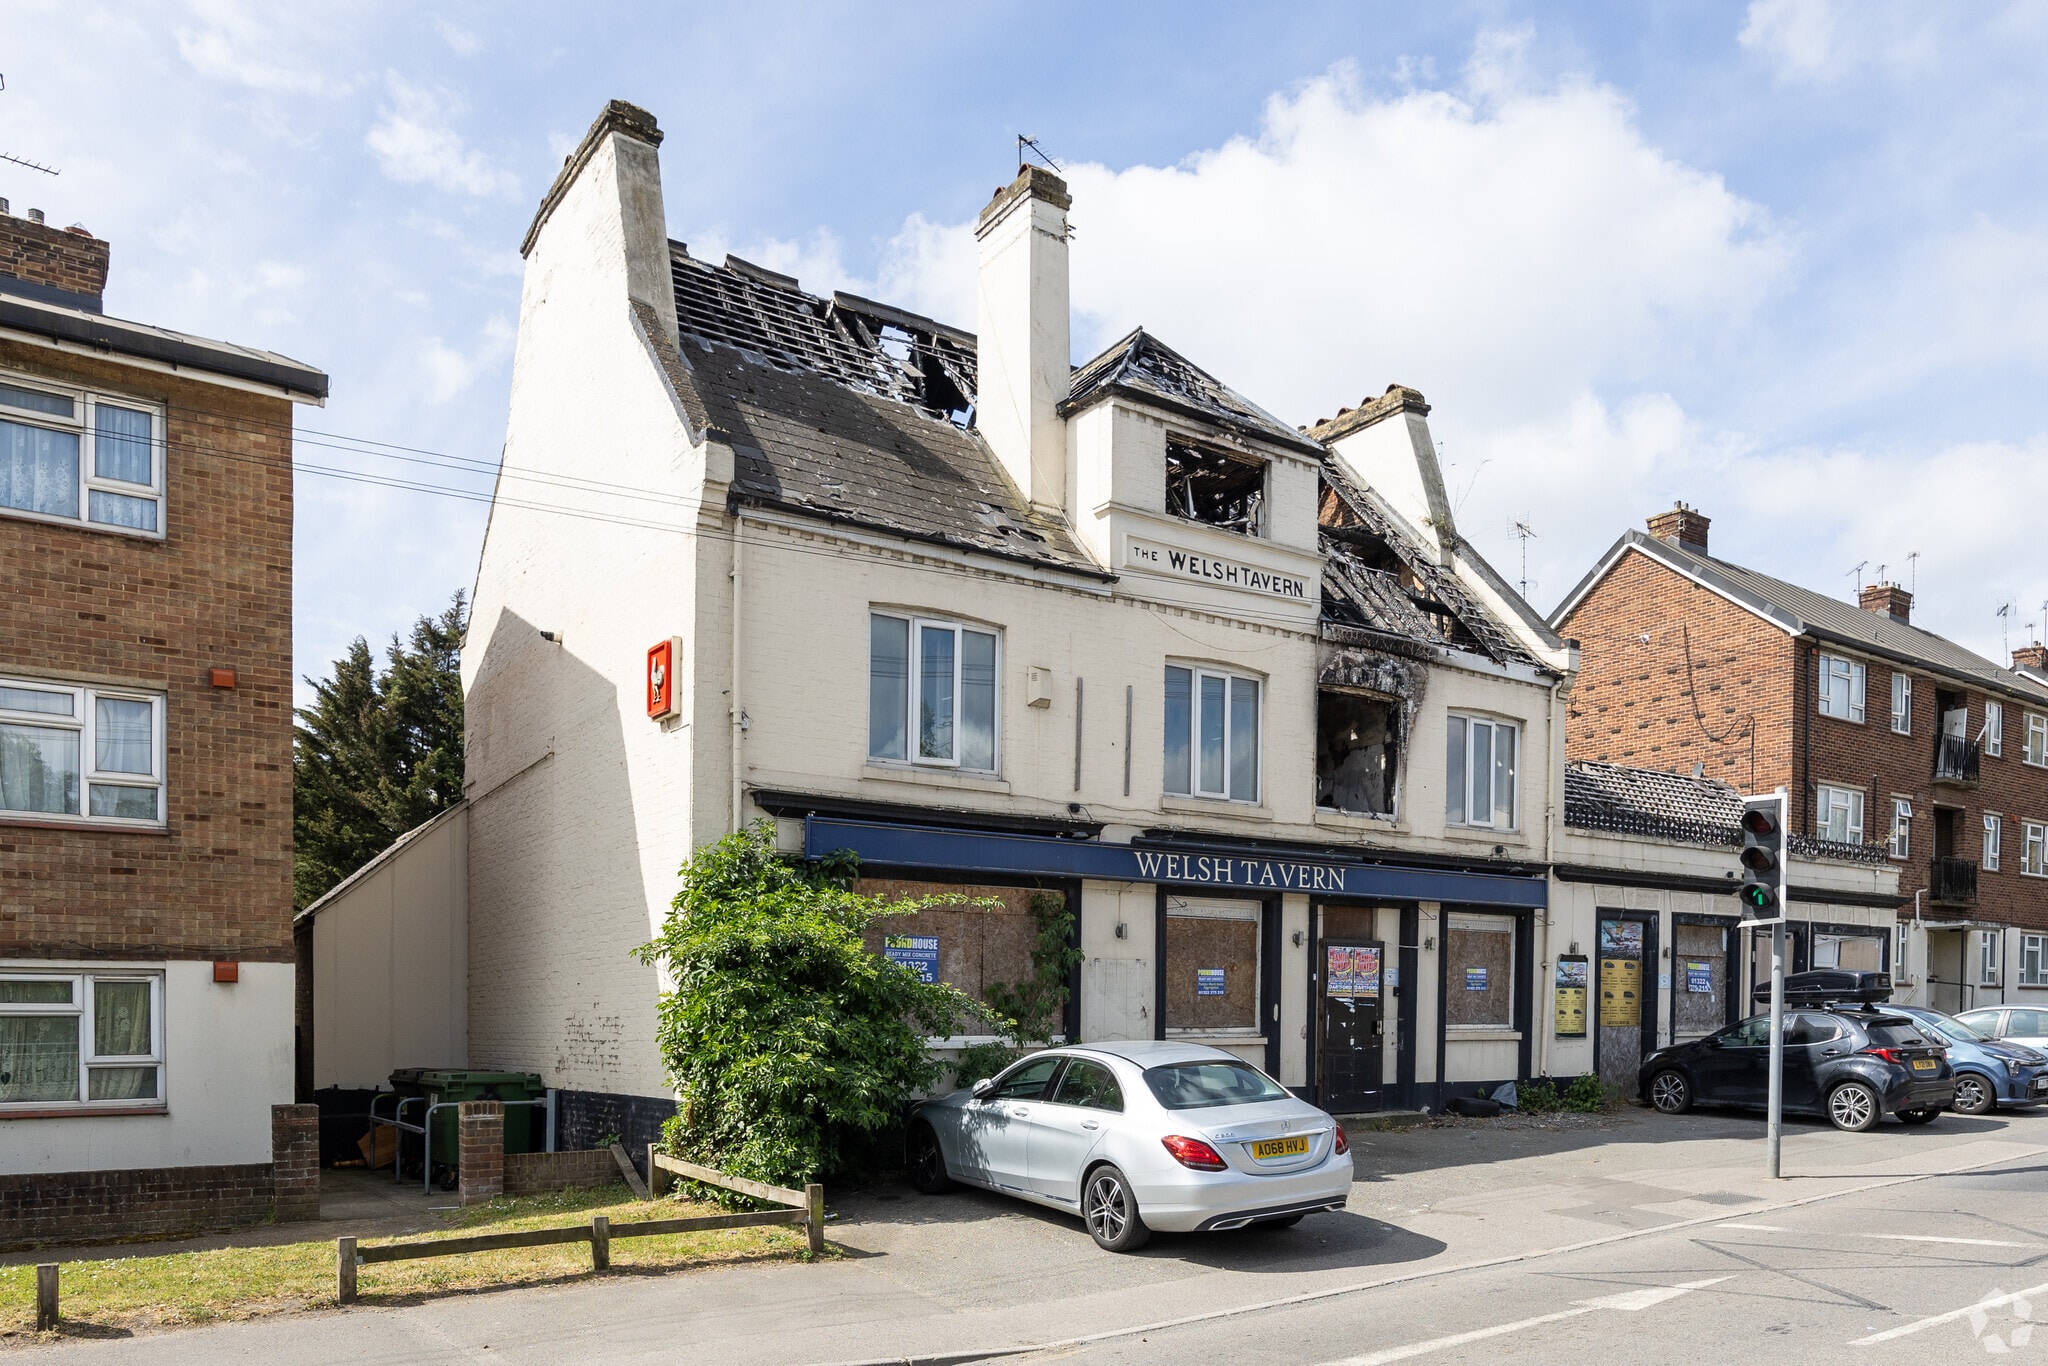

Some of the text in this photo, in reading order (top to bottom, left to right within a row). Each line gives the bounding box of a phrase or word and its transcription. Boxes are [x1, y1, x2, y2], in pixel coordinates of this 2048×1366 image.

[1133, 546, 1304, 598] THE WELSH TAVERN
[1134, 851, 1346, 891] WELSH TAVERN
[1691, 977, 1706, 985] 01322
[1258, 1140, 1305, 1156] AO68 HVJ
